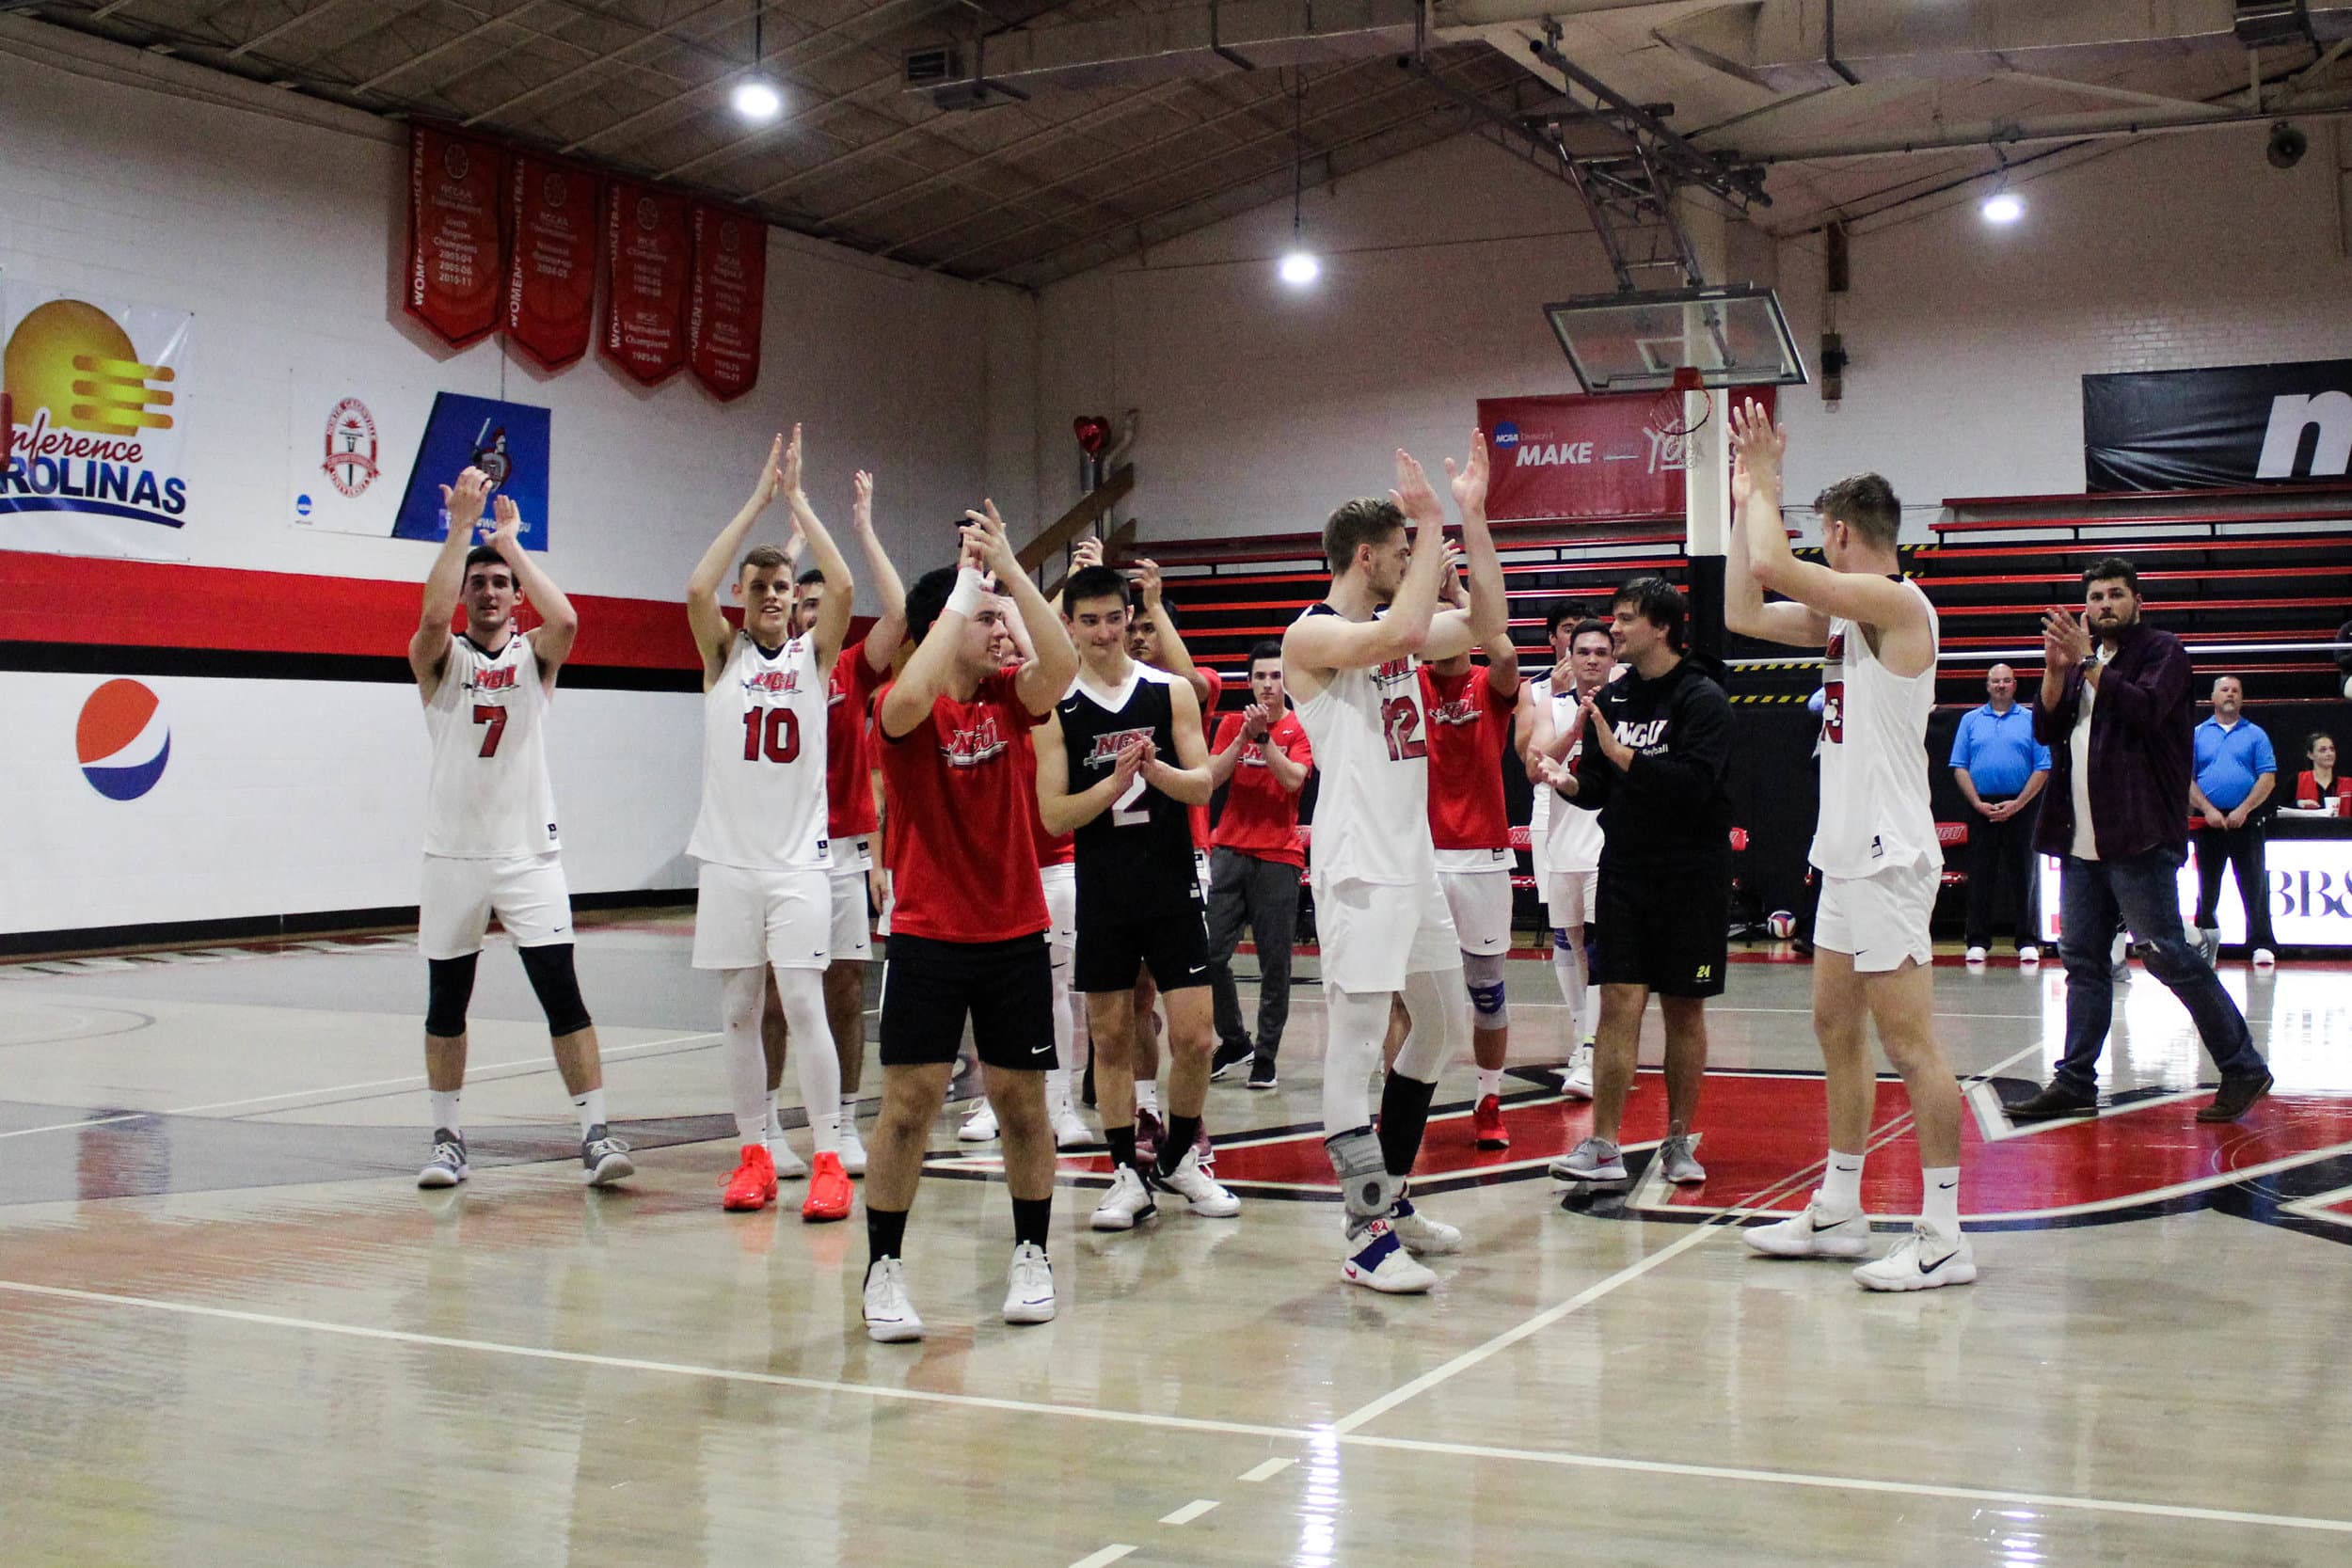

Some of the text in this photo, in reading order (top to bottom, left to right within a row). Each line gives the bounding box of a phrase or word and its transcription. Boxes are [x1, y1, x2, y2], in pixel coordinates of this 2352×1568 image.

[438, 273, 472, 287] 2010-11
[11, 413, 144, 463] nference
[1496, 434, 1518, 442] NCAA
[1516, 442, 1594, 467] MAKE
[0, 456, 186, 515] ROLINAS
[473, 705, 508, 758] 7
[742, 705, 800, 764] 10
[1092, 726, 1156, 757] NG
[1380, 695, 1429, 762] 12
[1613, 720, 1669, 748] NGU
[1111, 770, 1151, 827] 2
[1696, 964, 1711, 978] 24
